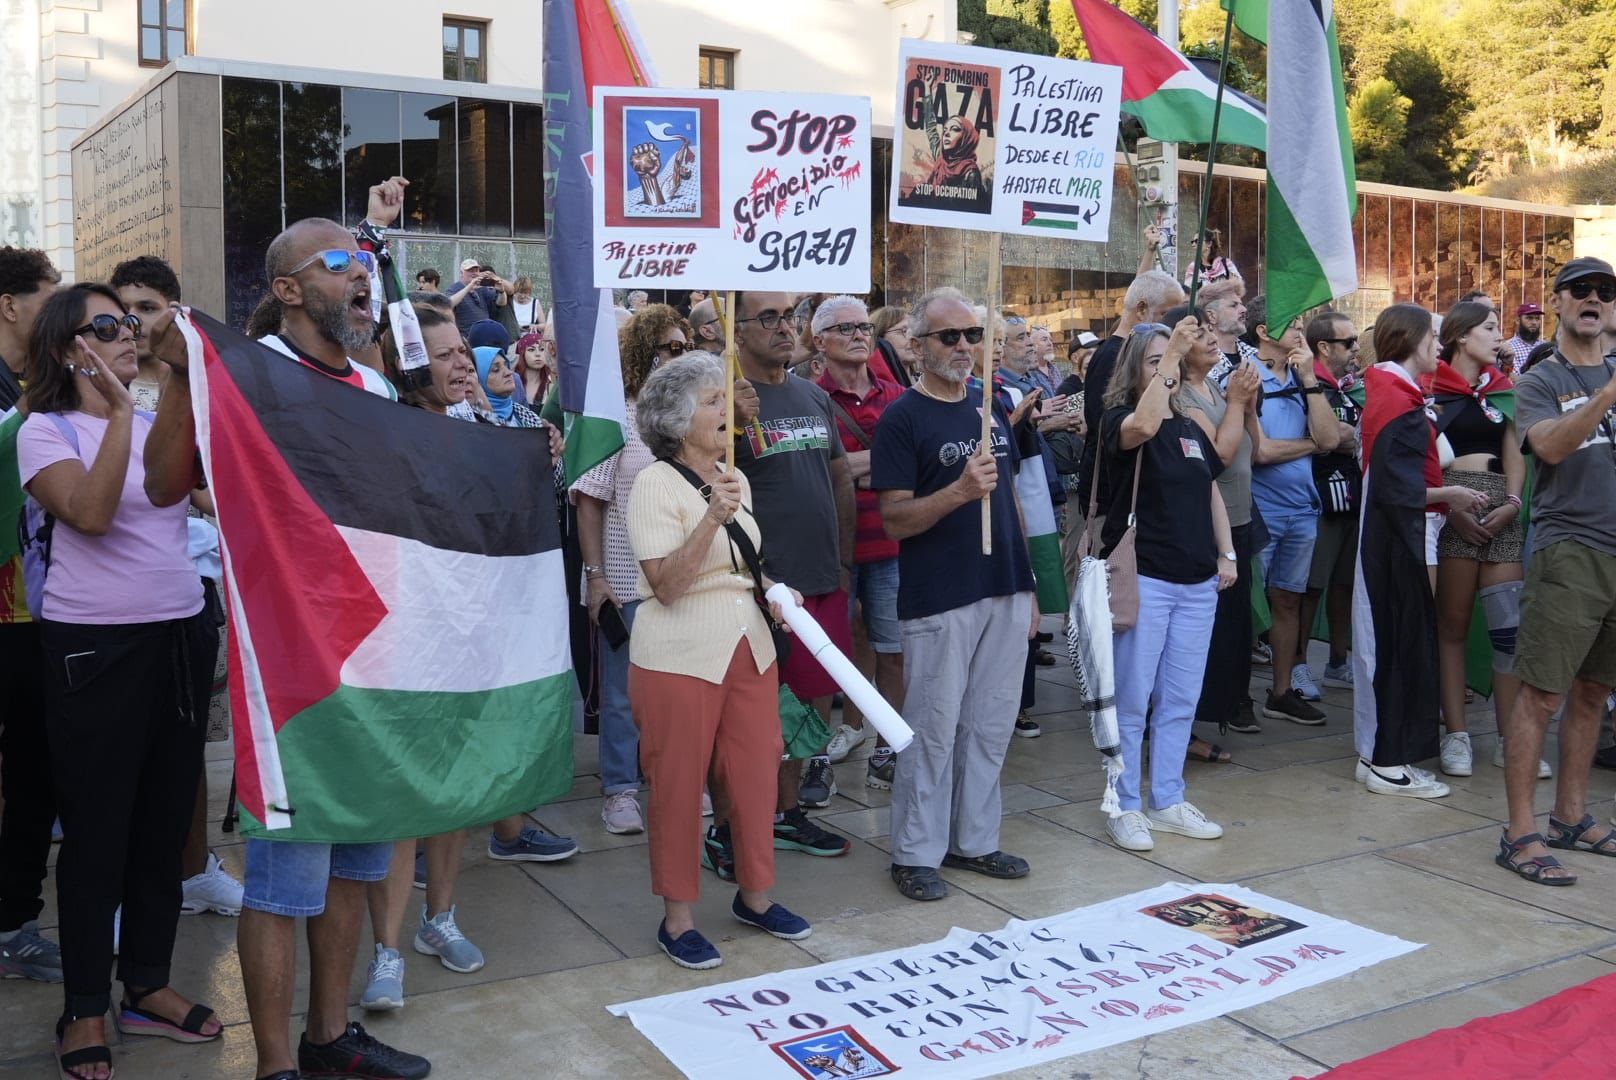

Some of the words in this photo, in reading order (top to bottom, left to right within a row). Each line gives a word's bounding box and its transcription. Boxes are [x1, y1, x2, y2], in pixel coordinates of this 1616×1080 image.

[916, 64, 942, 81] STOP
[944, 67, 989, 88] BOMBING
[905, 79, 994, 138] GAZA
[746, 109, 858, 157] STOP
[1005, 143, 1050, 165] DESDE
[1052, 151, 1069, 166] EL
[794, 185, 834, 216] EN
[915, 183, 934, 196] STOP
[935, 185, 978, 201] OCCUPATION
[1003, 175, 1047, 195] HASTA
[1048, 178, 1063, 195] EL
[1066, 176, 1103, 200] MAR
[747, 227, 858, 273] GAZA
[745, 416, 825, 439] PALESTINA
[702, 988, 791, 1017] NO
[885, 999, 1010, 1039] CON
[1021, 943, 1235, 1007] ISRAEL
[745, 1012, 828, 1042] NO
